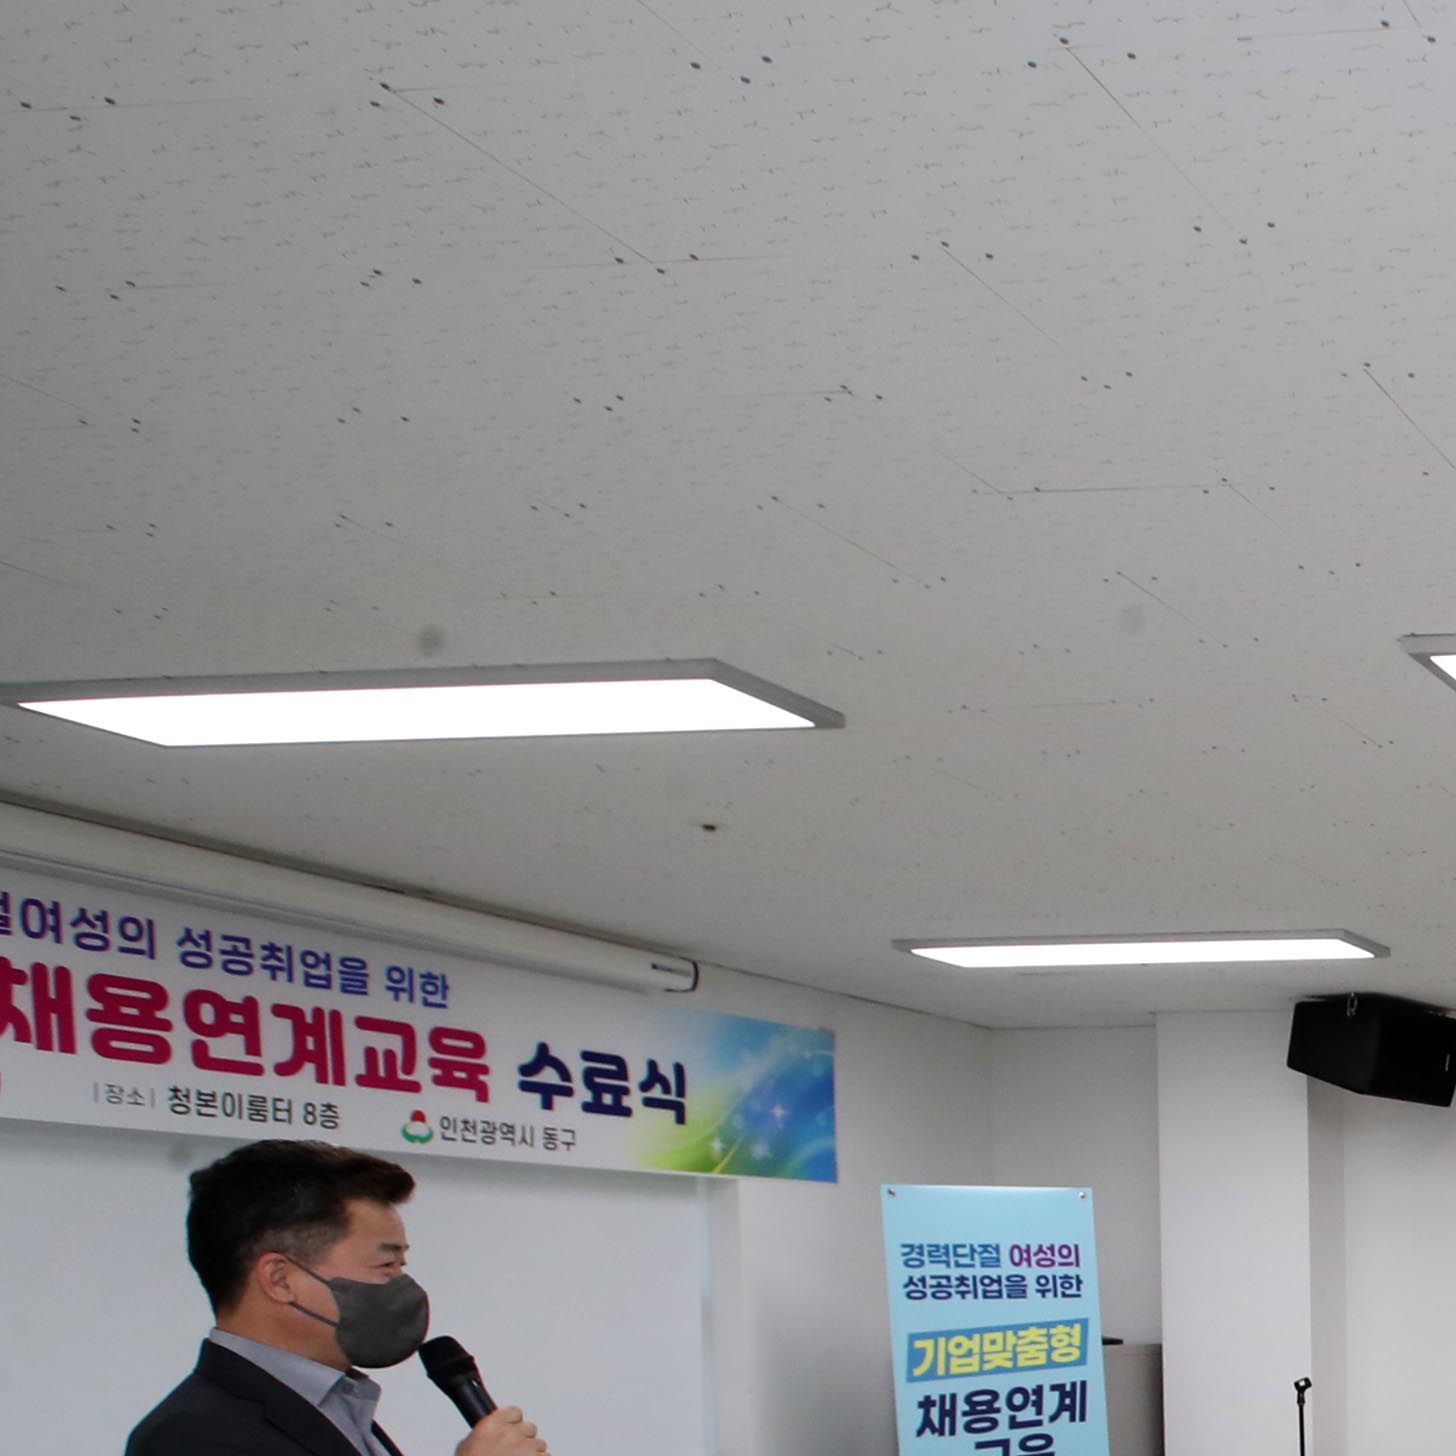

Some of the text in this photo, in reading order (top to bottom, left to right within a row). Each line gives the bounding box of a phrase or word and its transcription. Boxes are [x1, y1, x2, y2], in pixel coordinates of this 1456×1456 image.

[0, 891, 450, 1009] 여성의 성공취업을 위한
[0, 955, 686, 1126] 채용연계교육 수료식
[167, 1084, 293, 1125] 청본이룸터
[302, 1101, 340, 1131] 8층
[439, 1115, 577, 1152] 인천광역시 동구
[900, 1243, 1081, 1269] 경력단절 여성의
[902, 1273, 1083, 1301] 성공취업을 위한
[911, 1323, 1082, 1377] 기업맞춤형
[915, 1379, 1088, 1438] 채용연계
